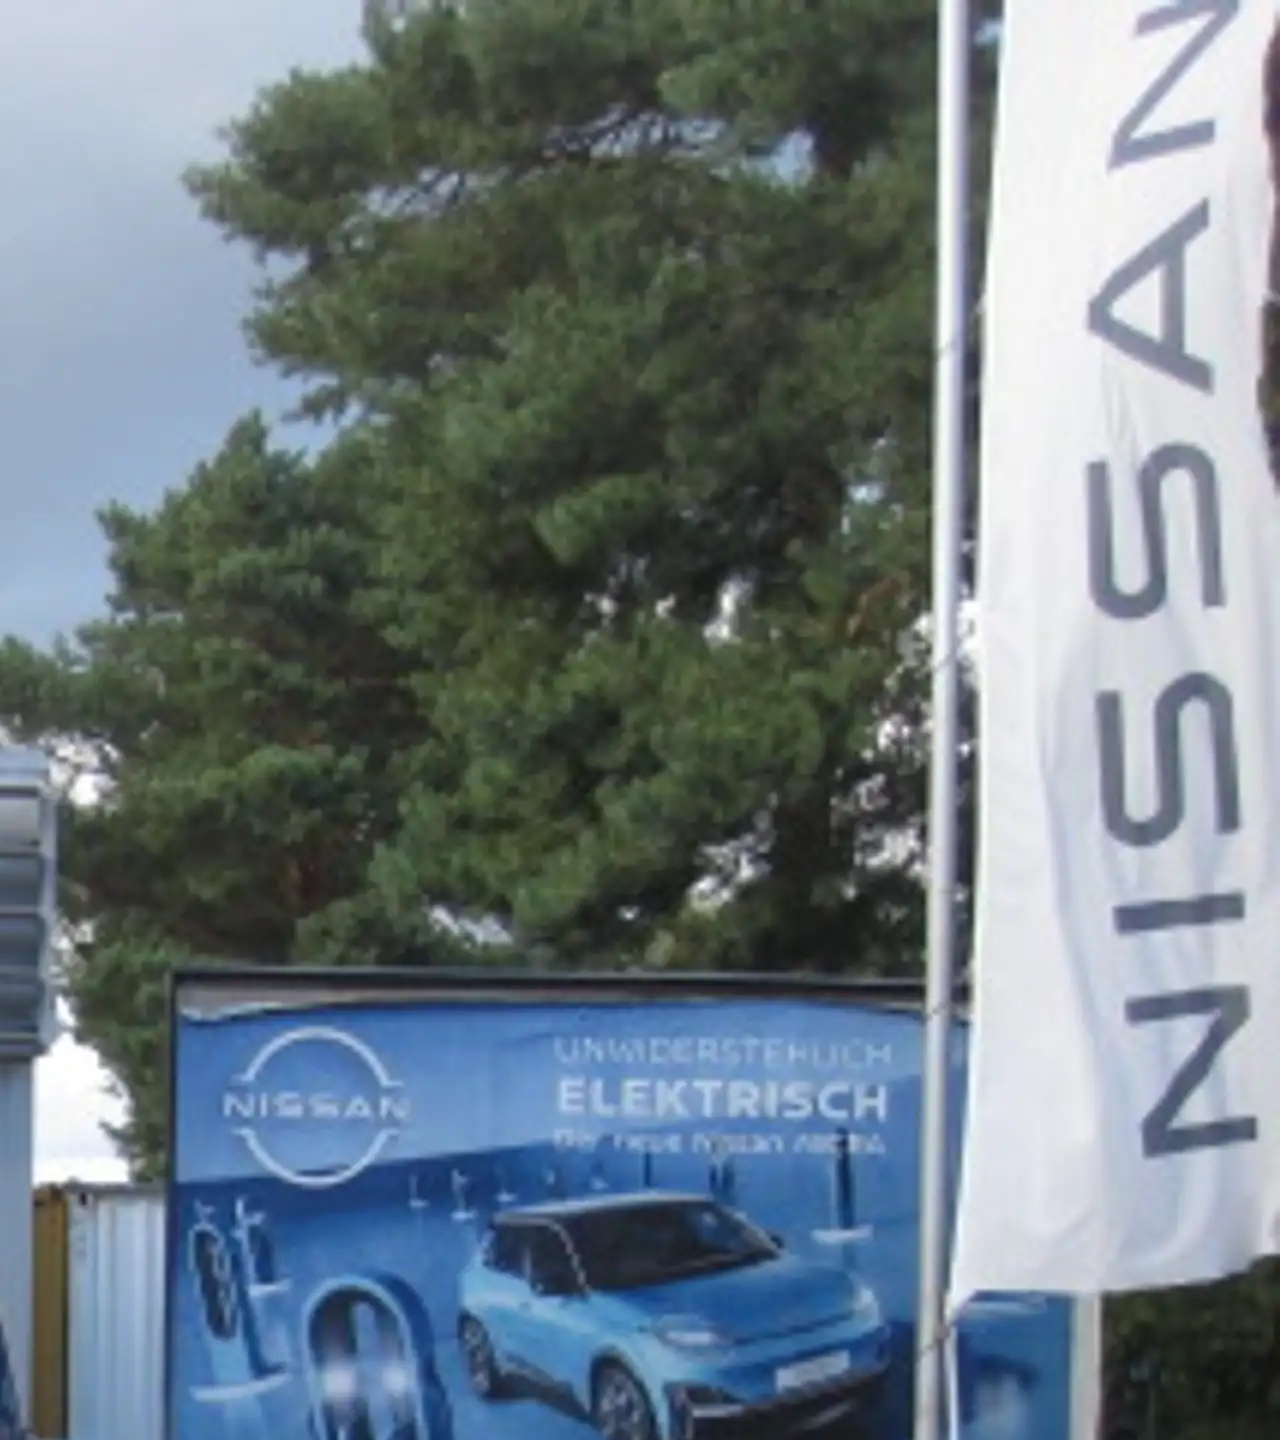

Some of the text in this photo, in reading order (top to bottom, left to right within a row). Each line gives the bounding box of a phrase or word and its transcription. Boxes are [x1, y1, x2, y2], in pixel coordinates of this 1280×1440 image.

[1088, 0, 1258, 1158] NISSAN
[223, 1092, 411, 1121] NISSAN
[556, 1076, 887, 1122] ELEKTRISCH
